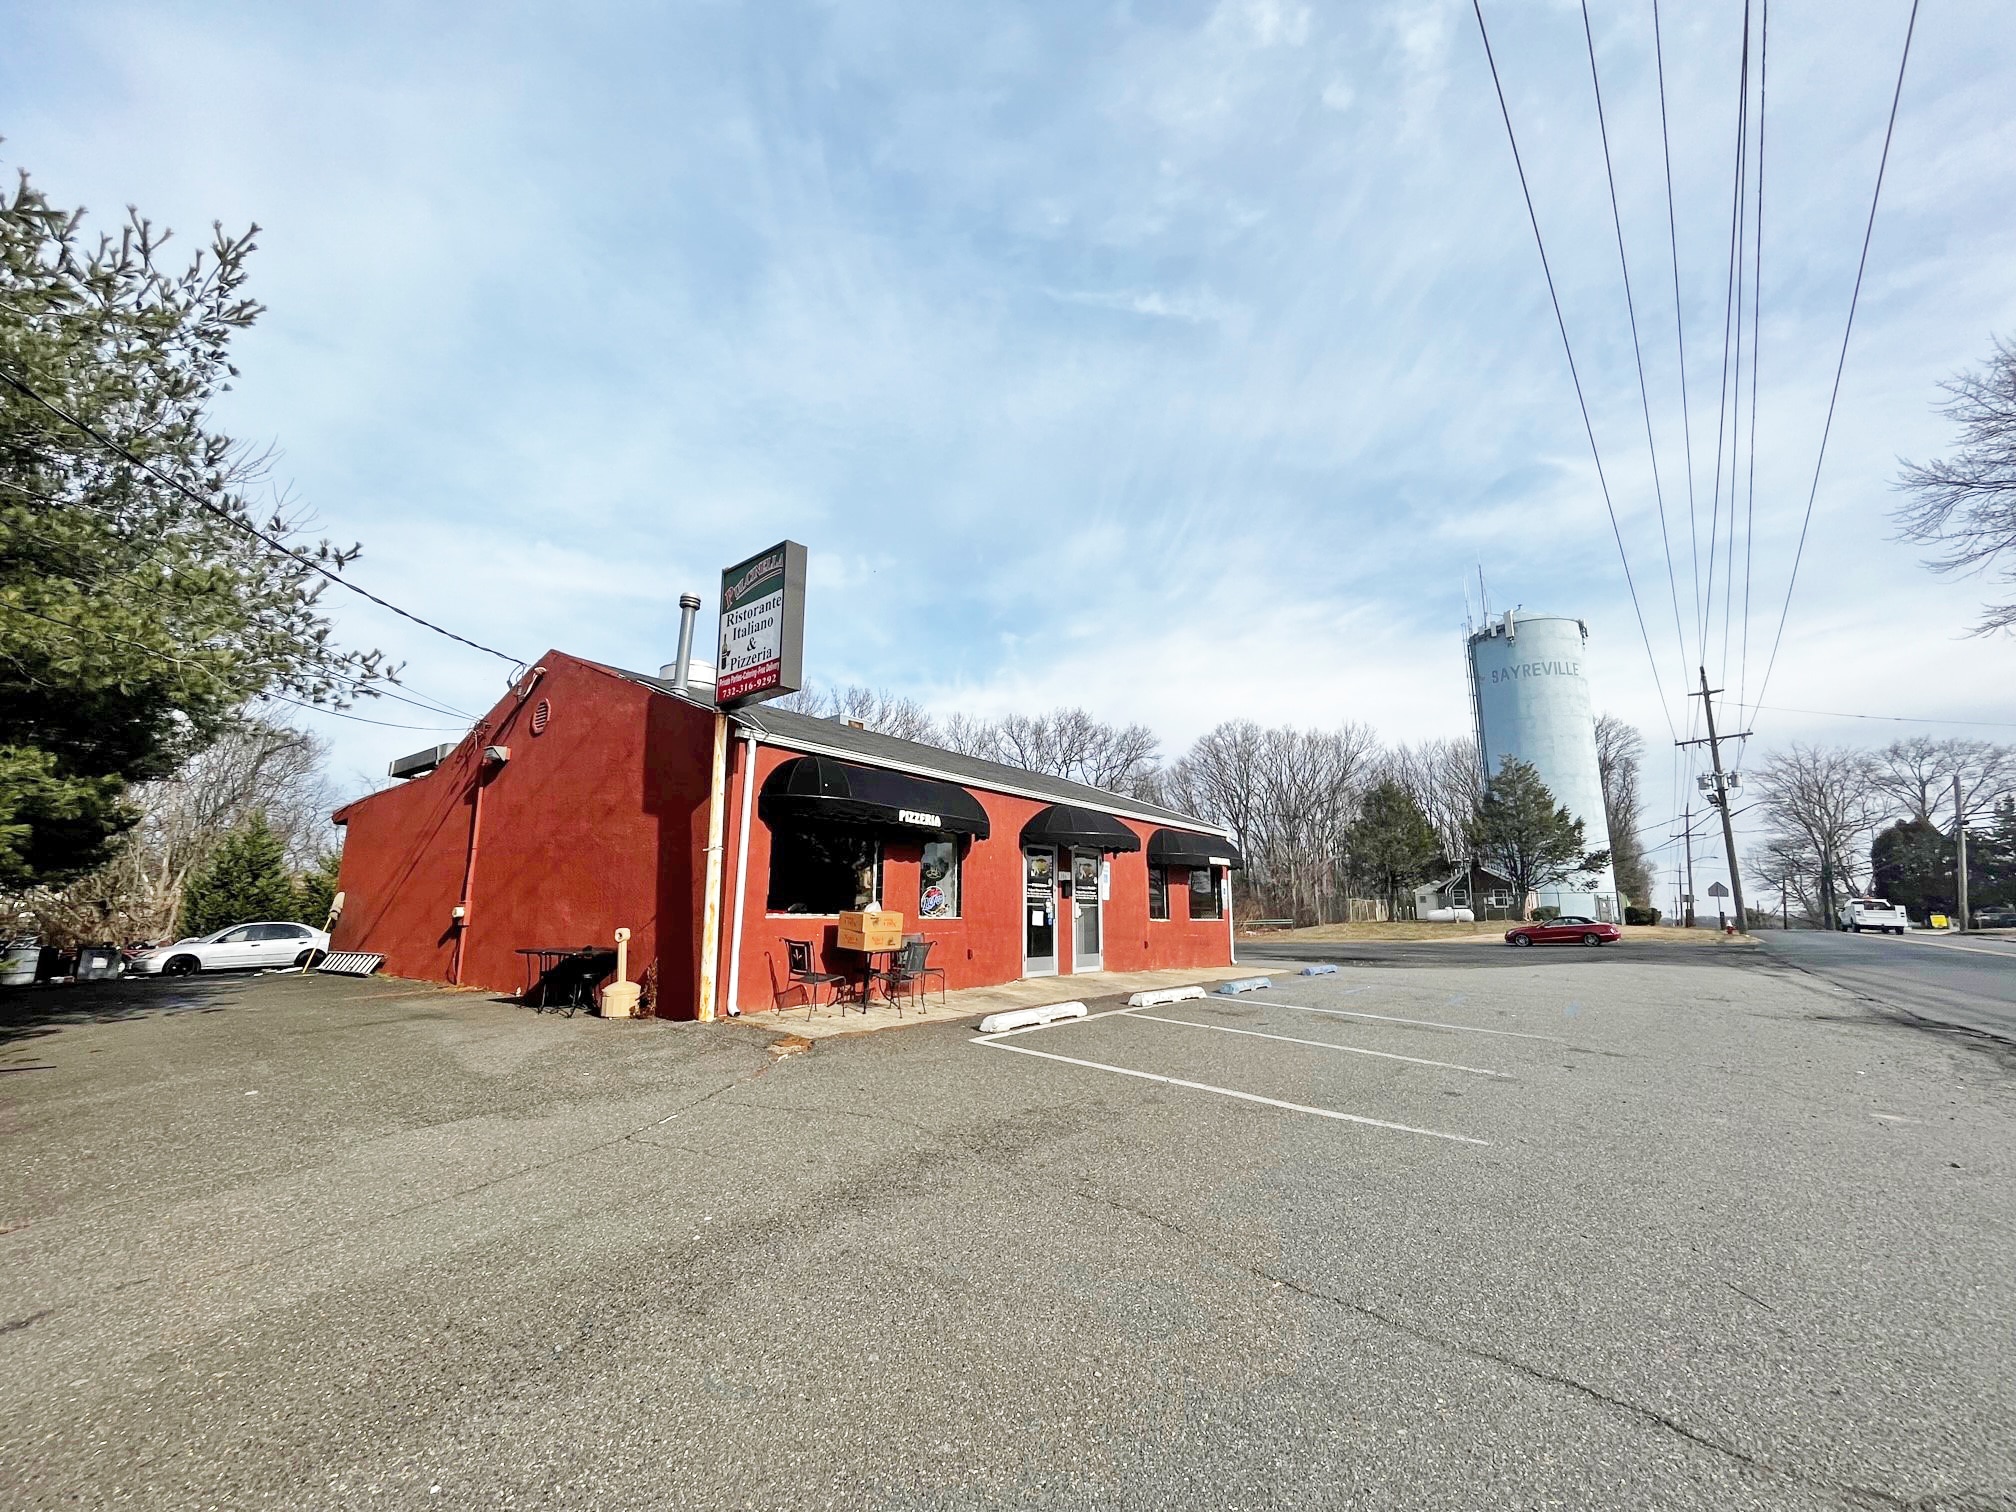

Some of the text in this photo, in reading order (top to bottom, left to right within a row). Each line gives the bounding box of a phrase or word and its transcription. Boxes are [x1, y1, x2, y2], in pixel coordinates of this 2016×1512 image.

[727, 596, 782, 628] Ristorante
[733, 617, 774, 641] Italiano
[747, 637, 757, 652] &
[730, 647, 772, 671] Pizzeria
[1491, 661, 1580, 684] SAYREVILLE
[722, 674, 777, 698] 732-316-9292
[898, 809, 942, 828] PIZZERIA
